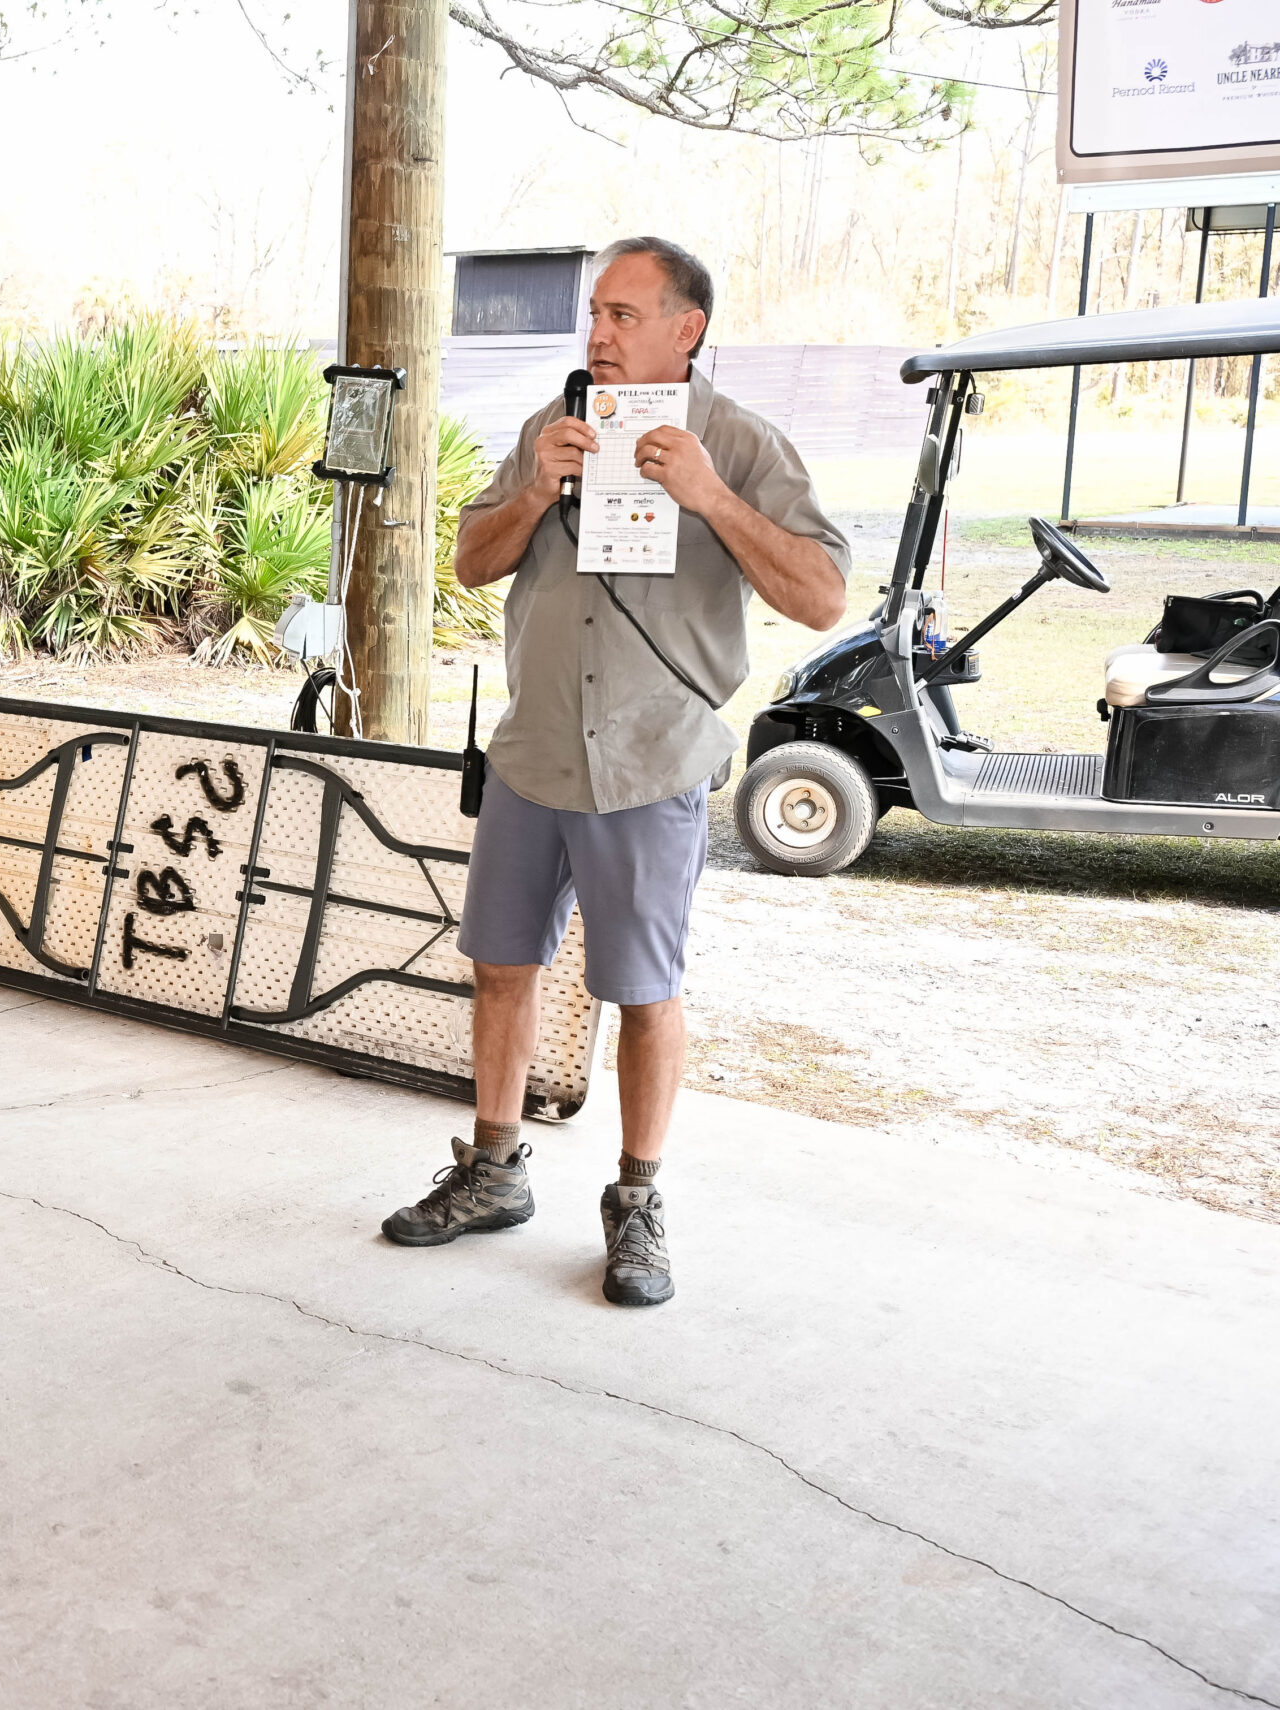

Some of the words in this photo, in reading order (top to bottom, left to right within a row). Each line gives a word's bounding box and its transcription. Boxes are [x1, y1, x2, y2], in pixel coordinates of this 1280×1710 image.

[1217, 70, 1248, 85] UNCLE
[1111, 85, 1156, 98] Pernod
[1159, 83, 1196, 95] Ricard
[633, 497, 655, 505] metro
[1215, 793, 1265, 804] ALOR
